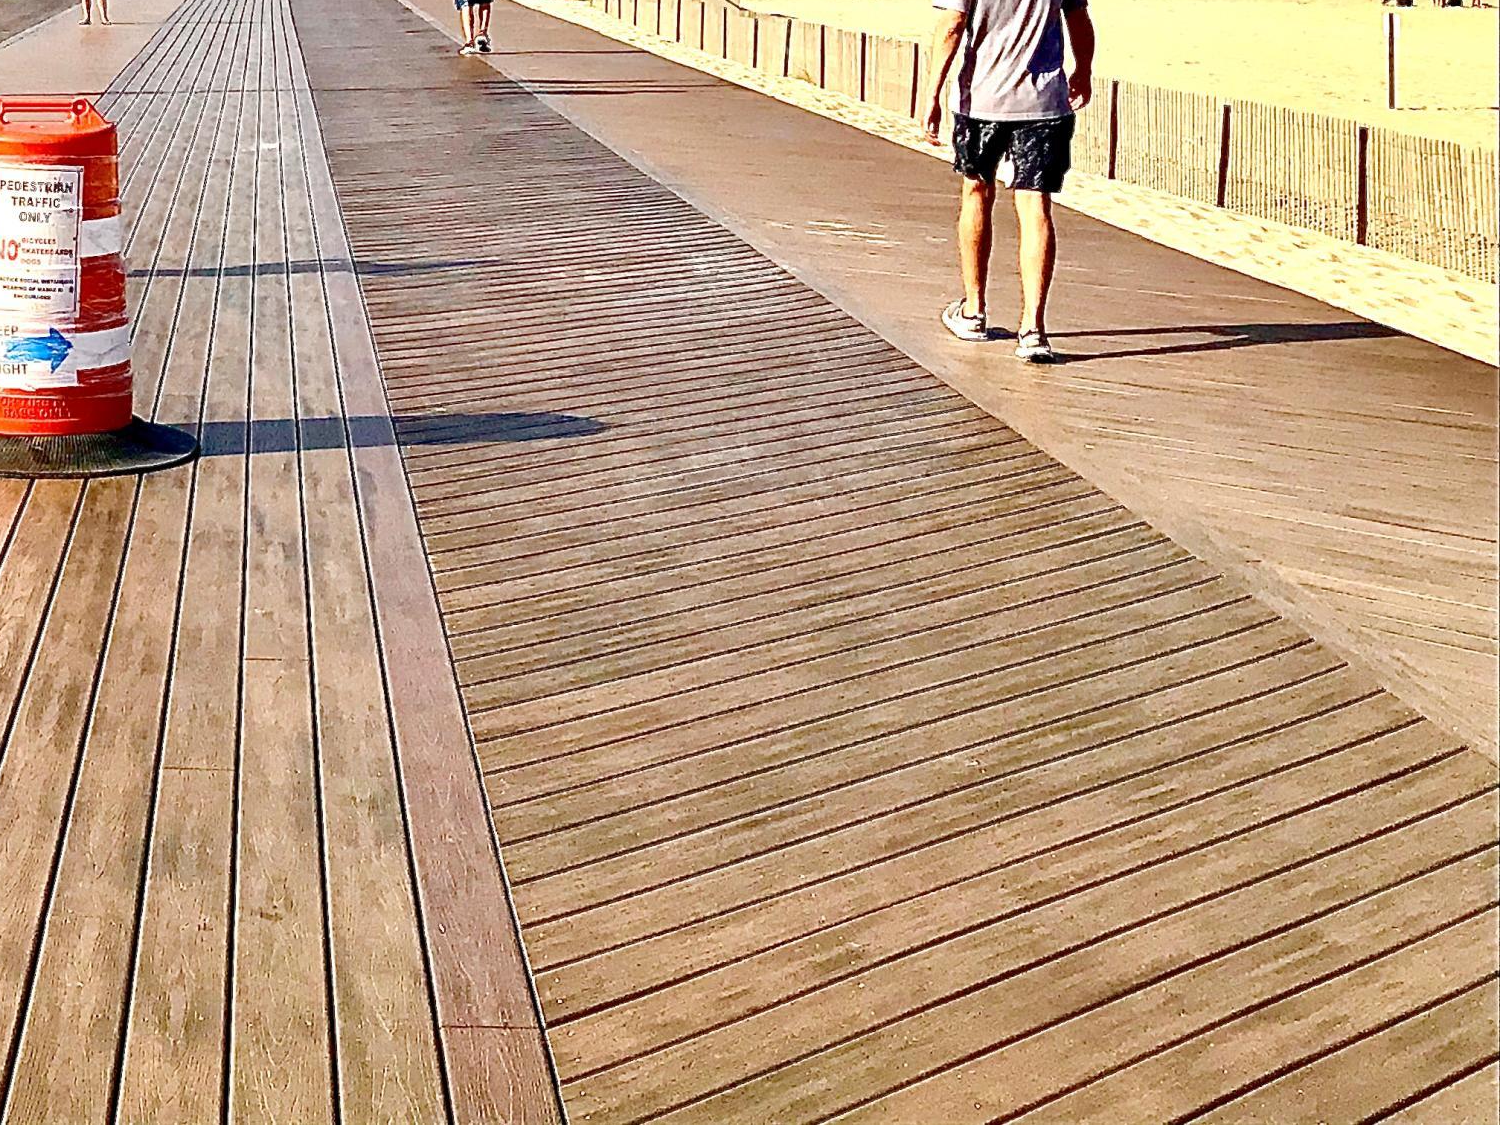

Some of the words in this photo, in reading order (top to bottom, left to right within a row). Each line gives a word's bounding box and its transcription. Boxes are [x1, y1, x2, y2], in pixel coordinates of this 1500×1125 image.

[0, 179, 74, 194] PEDESTRIAN
[11, 196, 61, 209] TRAFFIC
[18, 211, 52, 223] ONLY
[21, 237, 57, 245] BICYCLES
